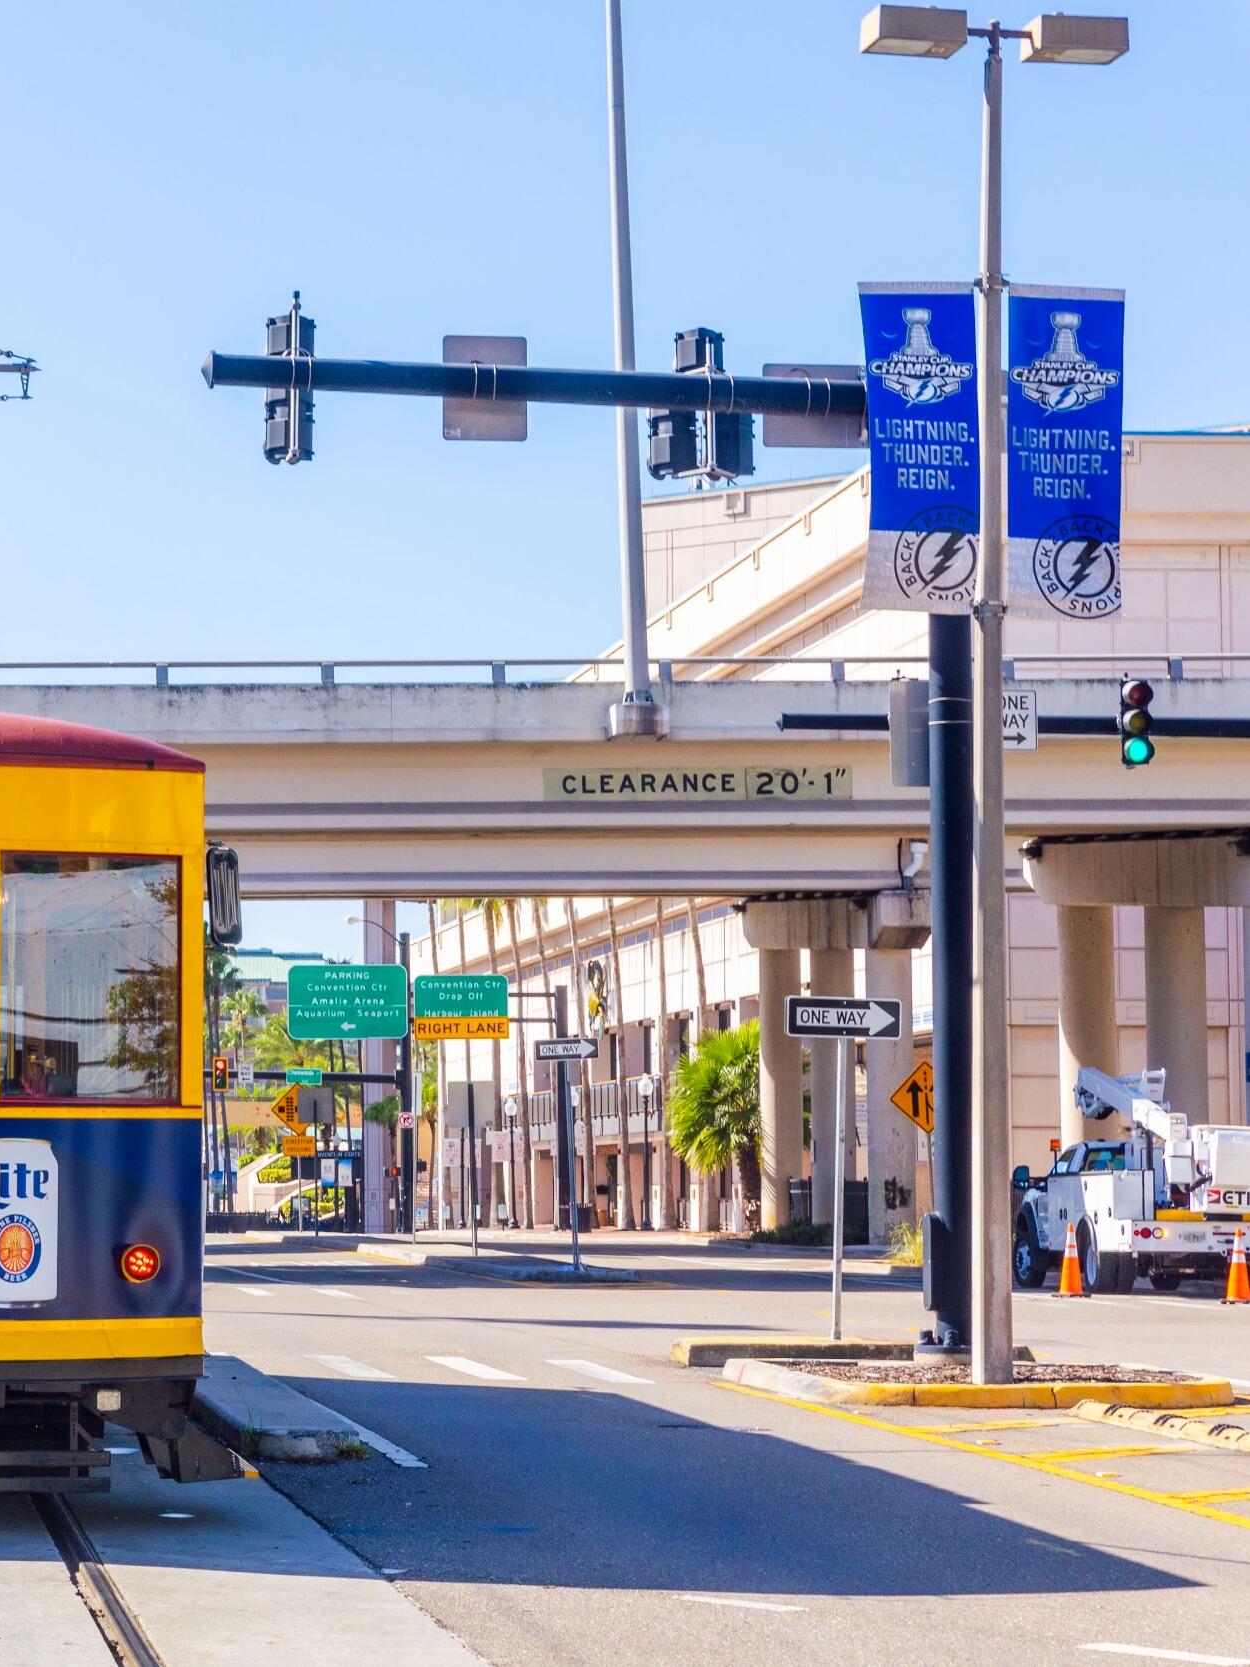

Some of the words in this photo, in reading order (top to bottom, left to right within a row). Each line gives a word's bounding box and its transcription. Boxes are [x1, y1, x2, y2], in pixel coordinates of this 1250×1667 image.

[892, 354, 929, 363] STANLEY
[930, 356, 950, 364] CUP
[1034, 361, 1075, 370] STANLEY
[1075, 362, 1096, 370] CUP
[870, 361, 971, 377] CHAMPIONS
[1012, 368, 1118, 385] CHAMPIONS
[874, 418, 975, 443] LIGHTNING.
[1012, 426, 1115, 451] LIGHTNING.
[881, 442, 969, 467] THUNDER.
[1018, 452, 1108, 475] THUNDER.
[897, 468, 955, 490] REIGN.
[1033, 477, 1091, 499] REIGN.
[901, 538, 917, 588] BACK
[922, 512, 967, 527] BACK
[1039, 546, 1059, 595] BACK
[1058, 520, 1108, 536] BACK
[562, 773, 735, 795] CLEARANCE
[324, 971, 370, 980] PARKING
[307, 983, 366, 991] Convention
[371, 983, 387, 991] Ctr
[420, 981, 479, 989] Convention
[484, 981, 501, 989] Ctr
[311, 997, 348, 1005] Amalie
[354, 997, 385, 1005] Arena
[439, 993, 463, 1001] Drop
[468, 992, 483, 1000] Off
[296, 1009, 345, 1018] Aquarium
[357, 1009, 399, 1018] Seaport
[424, 1009, 463, 1017] Harbour
[800, 1009, 830, 1024] ONE
[836, 1010, 866, 1025] WAY
[418, 1023, 461, 1034] RIGHT
[467, 1023, 505, 1034] LANE
[542, 1046, 559, 1054] ONE
[562, 1045, 579, 1053] WAY
[14, 1215, 40, 1245] PILSNER
[3, 1273, 28, 1281] BEER
